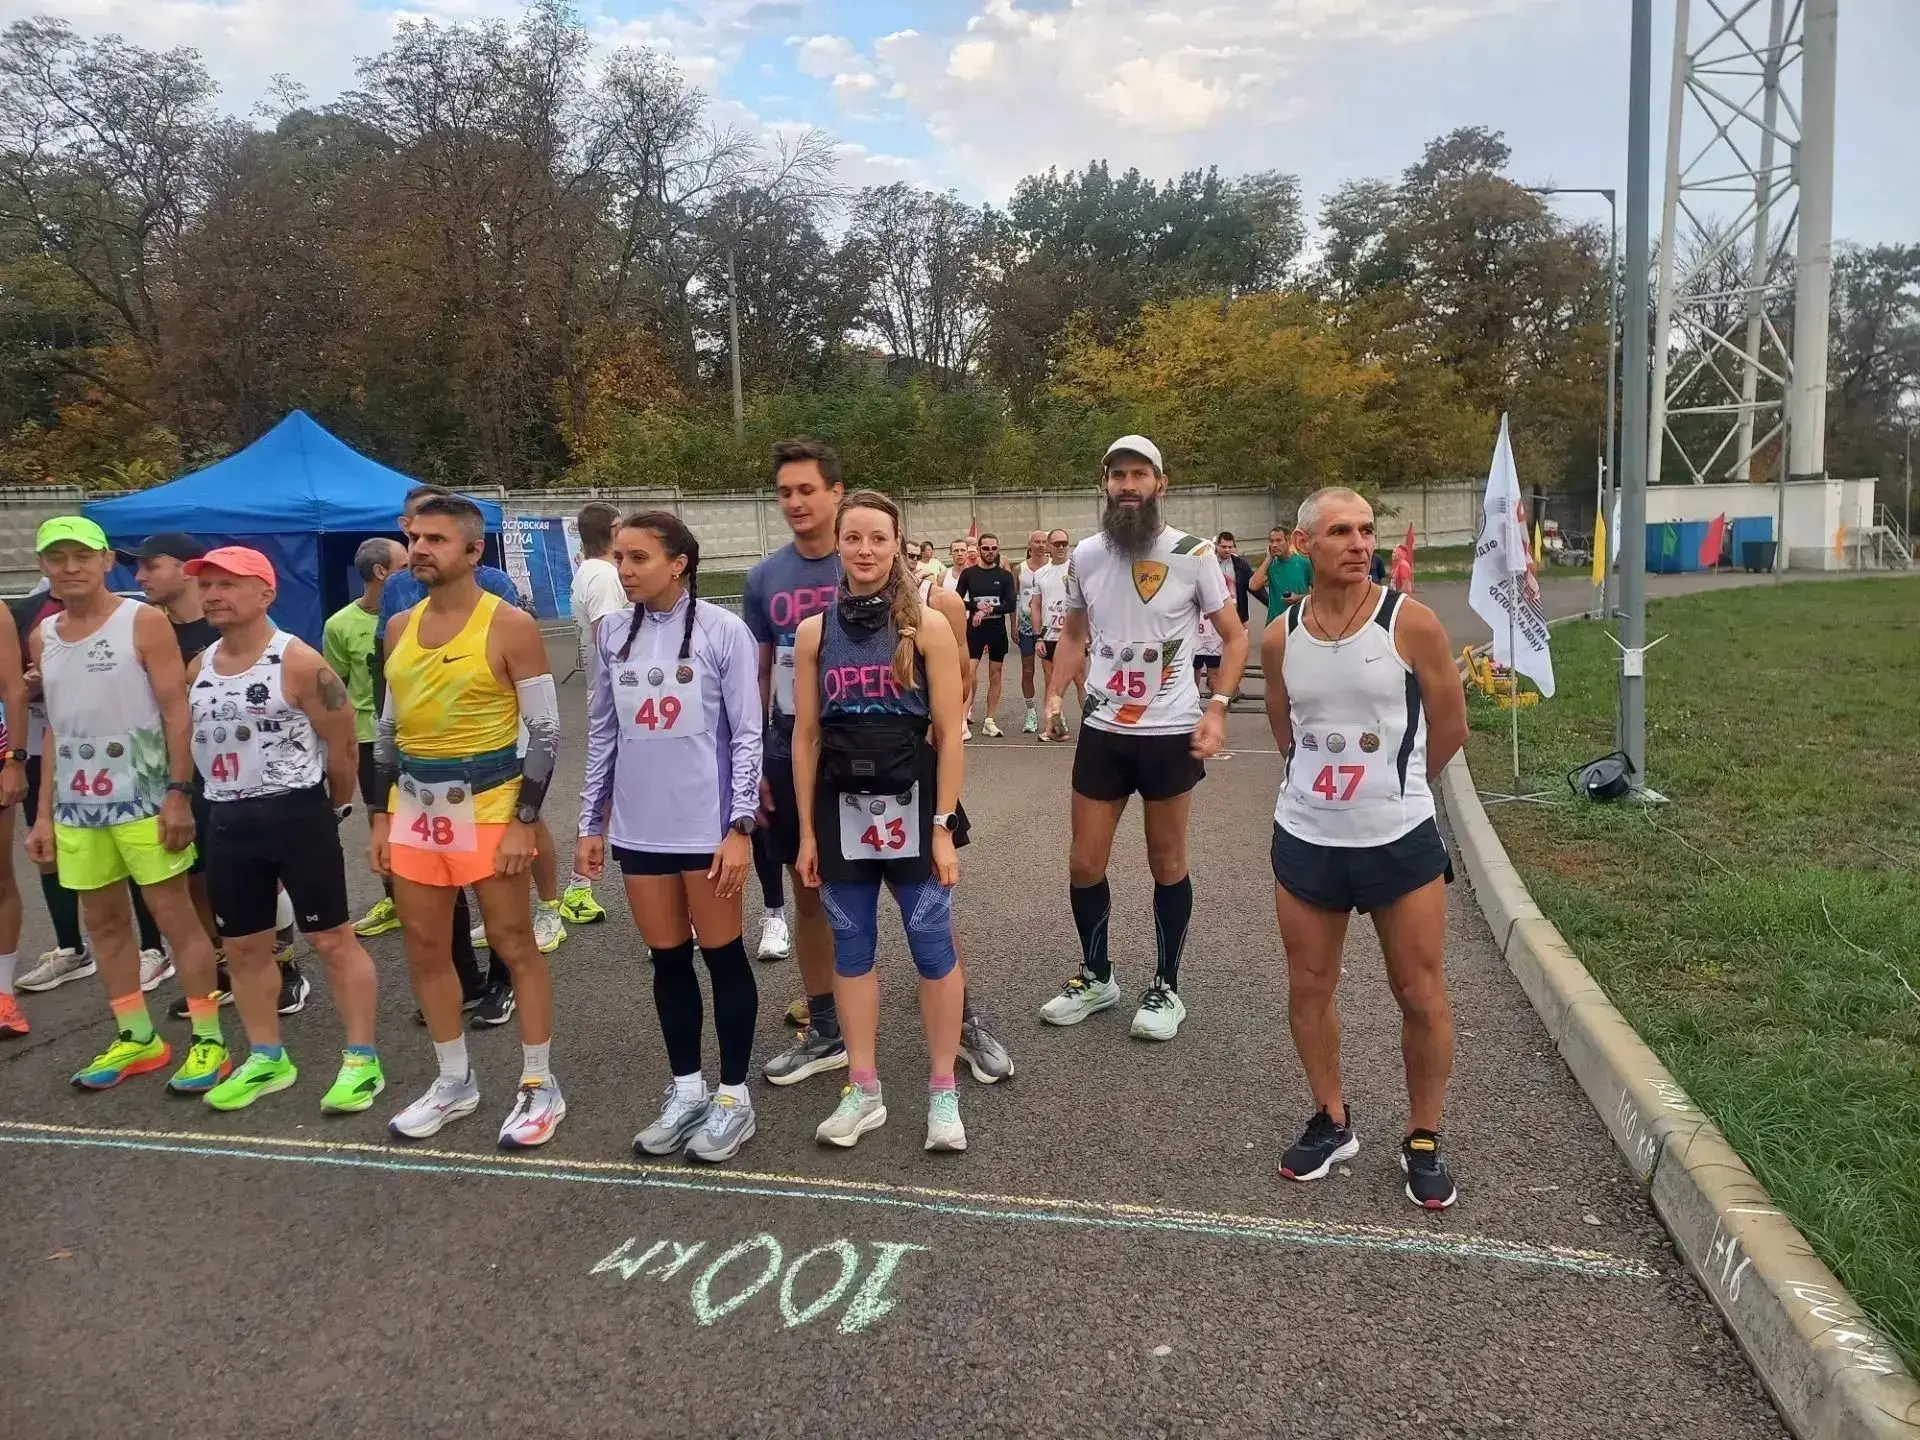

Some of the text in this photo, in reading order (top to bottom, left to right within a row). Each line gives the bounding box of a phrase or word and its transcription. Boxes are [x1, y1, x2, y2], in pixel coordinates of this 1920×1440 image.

[501, 520, 550, 530] ОСТОВСКАЯ
[503, 532, 534, 545] ОТКА
[1106, 670, 1147, 699] 45
[635, 696, 682, 731] 49
[70, 767, 114, 797] 46
[1312, 765, 1365, 801] 47
[411, 811, 454, 846] 48
[861, 817, 906, 852] 43
